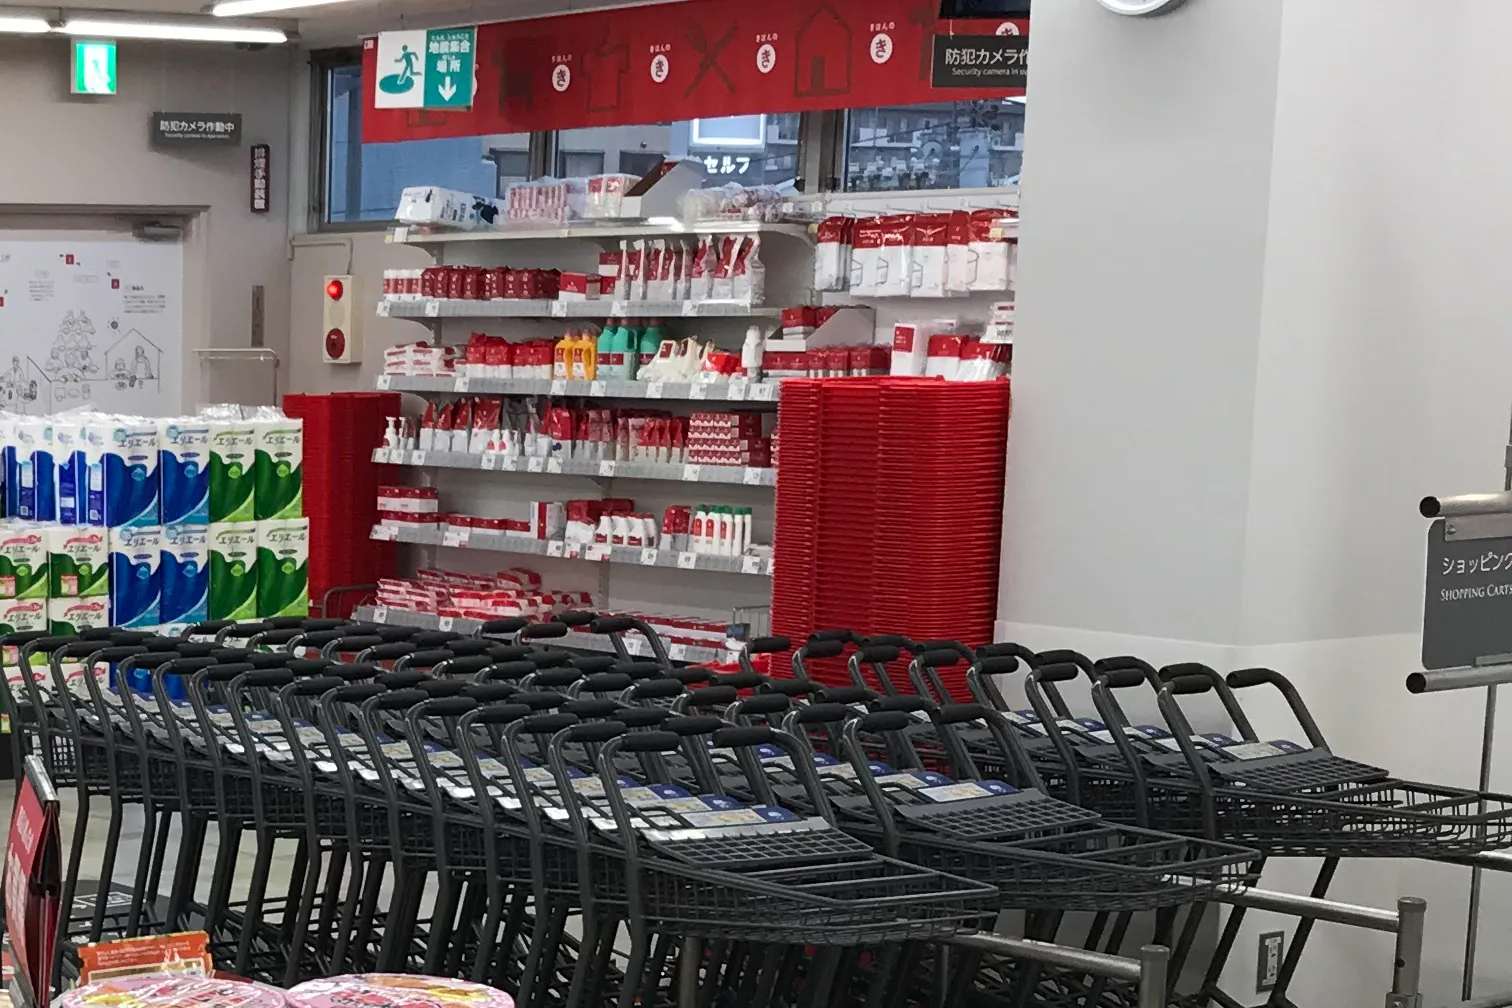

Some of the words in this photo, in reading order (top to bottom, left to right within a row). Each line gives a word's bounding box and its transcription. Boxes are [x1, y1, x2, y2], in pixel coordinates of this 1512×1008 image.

[760, 48, 771, 69] き
[874, 38, 887, 60] き
[556, 68, 567, 88] き
[654, 59, 665, 79] き
[160, 120, 235, 132] 防犯カメラ作動中
[703, 155, 750, 176] セルフ
[1440, 586, 1485, 601] SHOPPING
